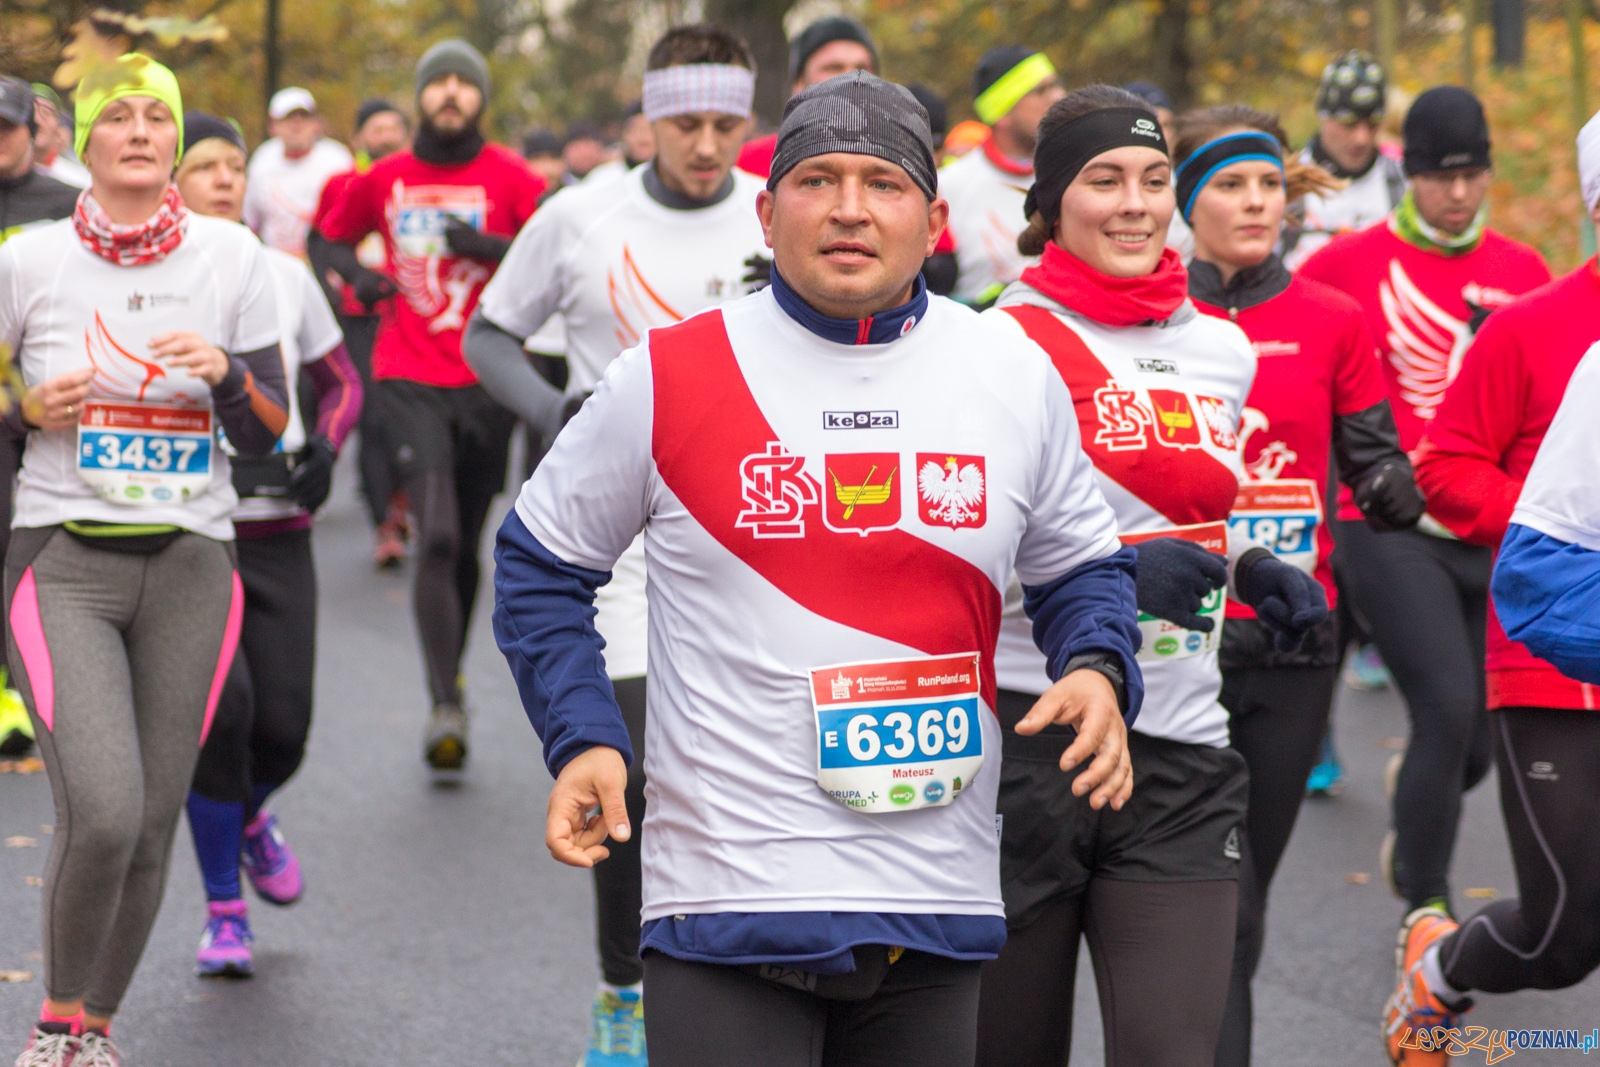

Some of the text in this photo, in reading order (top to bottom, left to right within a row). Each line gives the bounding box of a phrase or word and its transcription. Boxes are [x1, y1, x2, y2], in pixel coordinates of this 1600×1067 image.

[828, 412, 894, 428] keeza
[82, 434, 199, 472] E 3437
[856, 677, 866, 693] 1
[917, 673, 970, 687] RunPoland.org
[825, 706, 969, 761] E 6369
[892, 767, 934, 779] Mateusz
